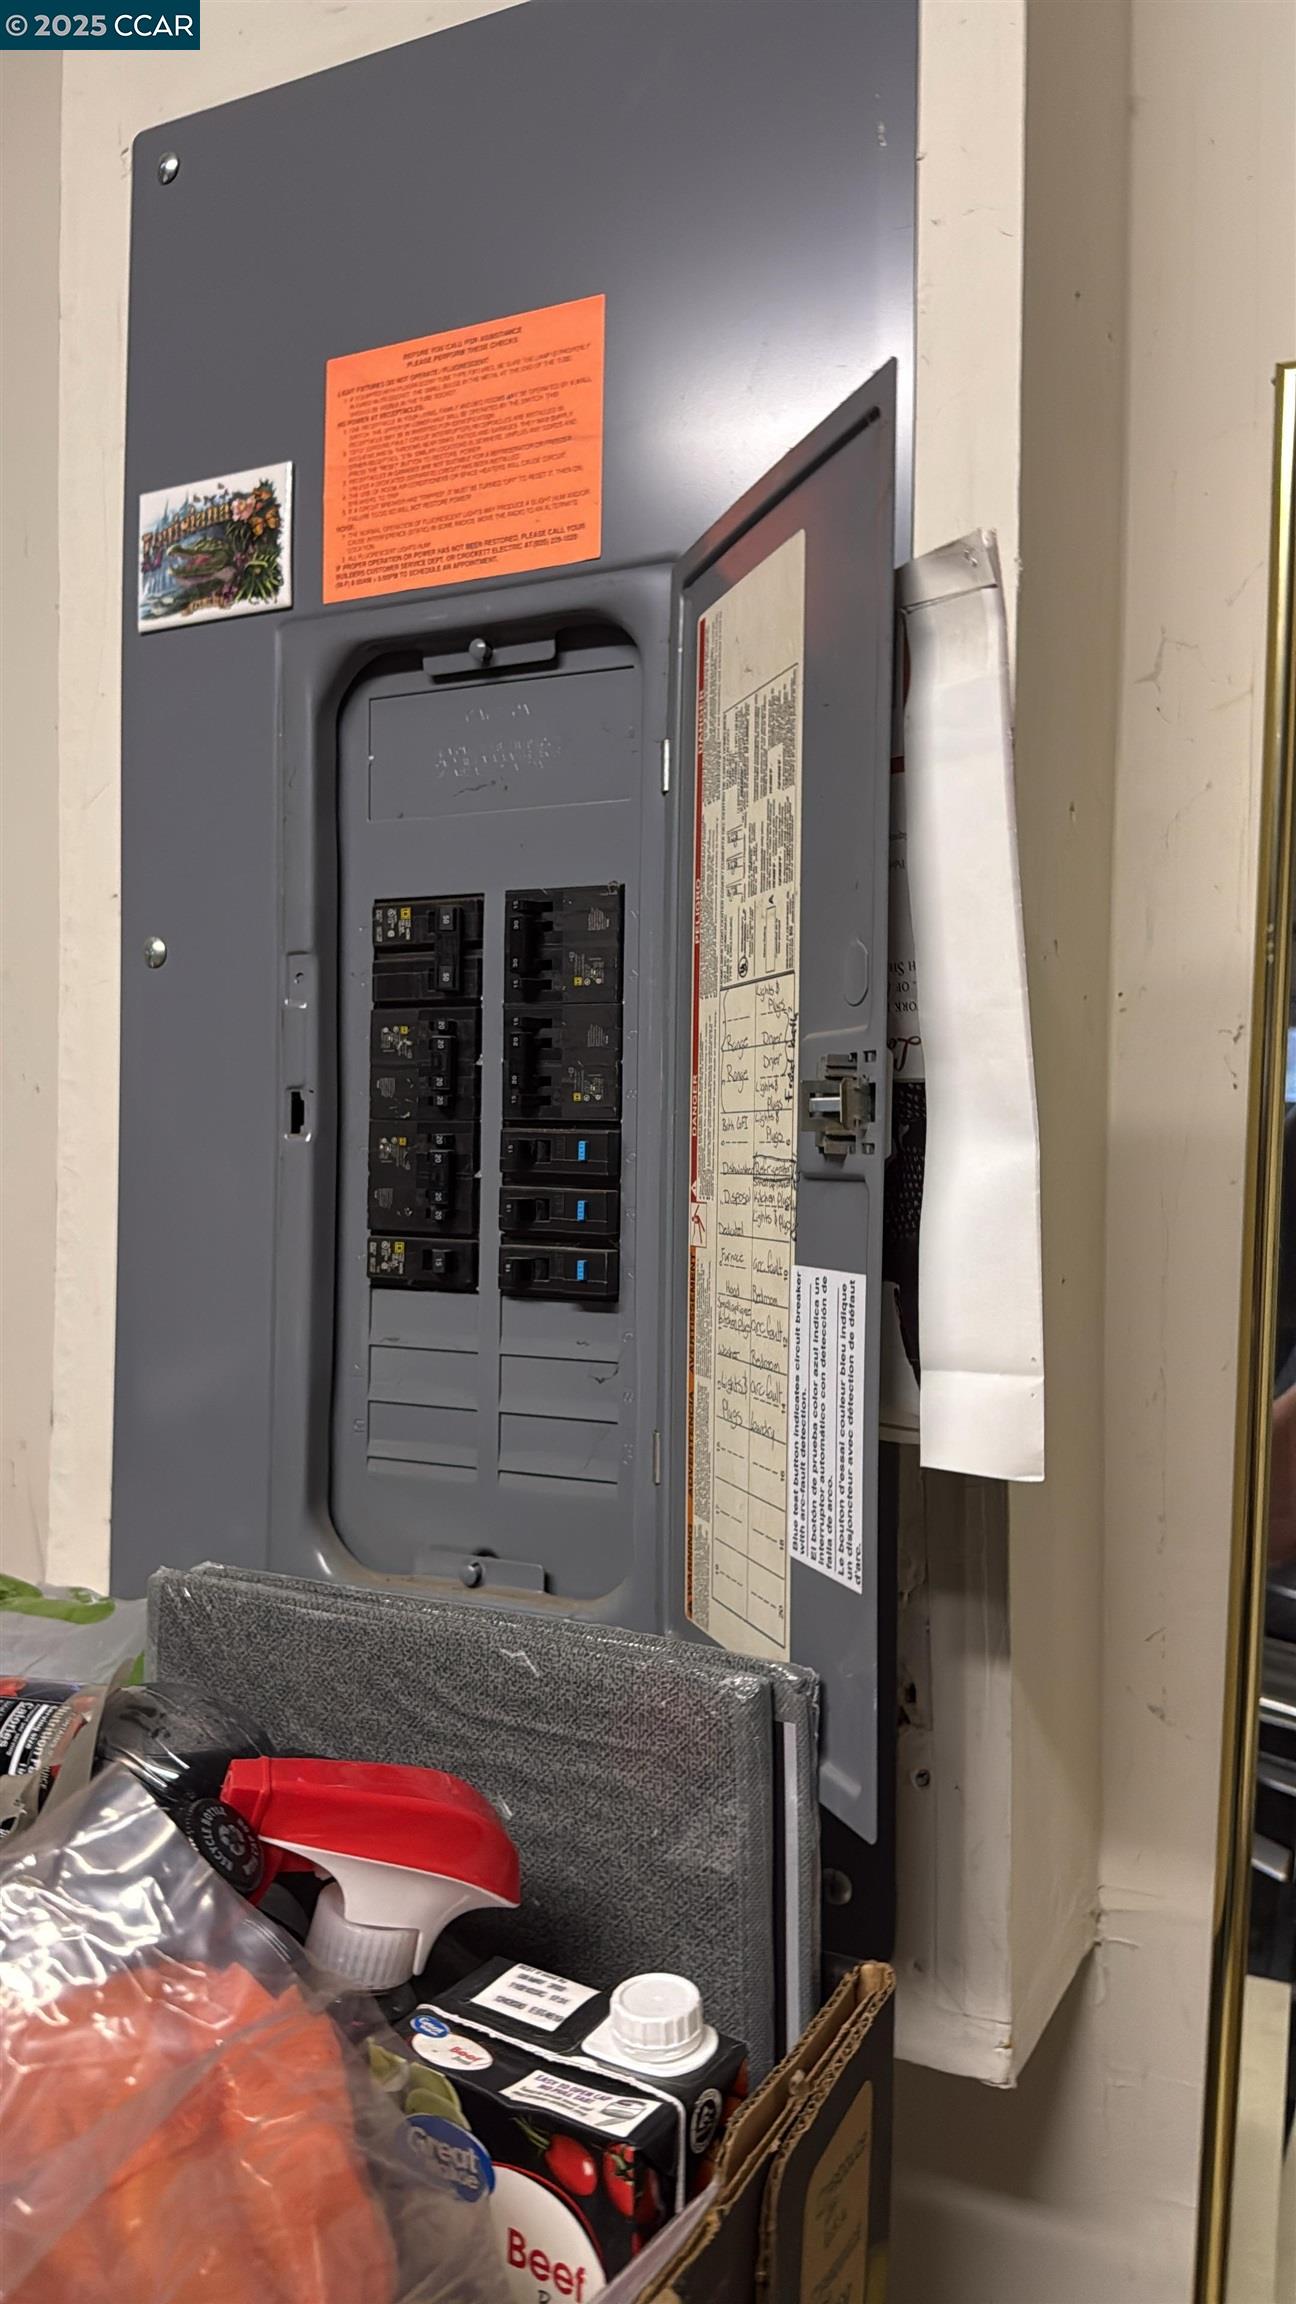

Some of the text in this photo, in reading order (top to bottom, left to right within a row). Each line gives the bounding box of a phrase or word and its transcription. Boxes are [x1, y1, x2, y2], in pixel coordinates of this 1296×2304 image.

[406, 356, 431, 368] PLEASE
[433, 348, 464, 362] PERFORM
[342, 561, 366, 571] PROPER
[368, 554, 401, 566] OPERATION
[413, 548, 435, 558] POWER
[366, 563, 398, 575] CUSTOMER
[400, 558, 425, 569] SERVICE
[755, 982, 774, 1002] Lights
[727, 1034, 748, 1060] Range
[761, 1031, 782, 1050] Dryer
[763, 1053, 782, 1072] Dryer
[727, 1064, 748, 1093] Range
[814, 1277, 820, 1295] un
[821, 1276, 828, 1294] de
[848, 1332, 855, 1350] de
[751, 1349, 780, 1372] Bedroom
[811, 1477, 817, 1496] de
[846, 1469, 854, 1556] disjoncteur
[826, 1516, 833, 1534] de
[811, 1547, 817, 1560] El
[838, 1557, 844, 1576] Le
[847, 1561, 853, 1580] un
[0, 1702, 34, 1748] Calories
[26, 1732, 39, 1750] size
[200, 1827, 233, 1871] RECYCLE
[449, 2046, 482, 2063] Beef
[508, 2226, 586, 2303] Beef
